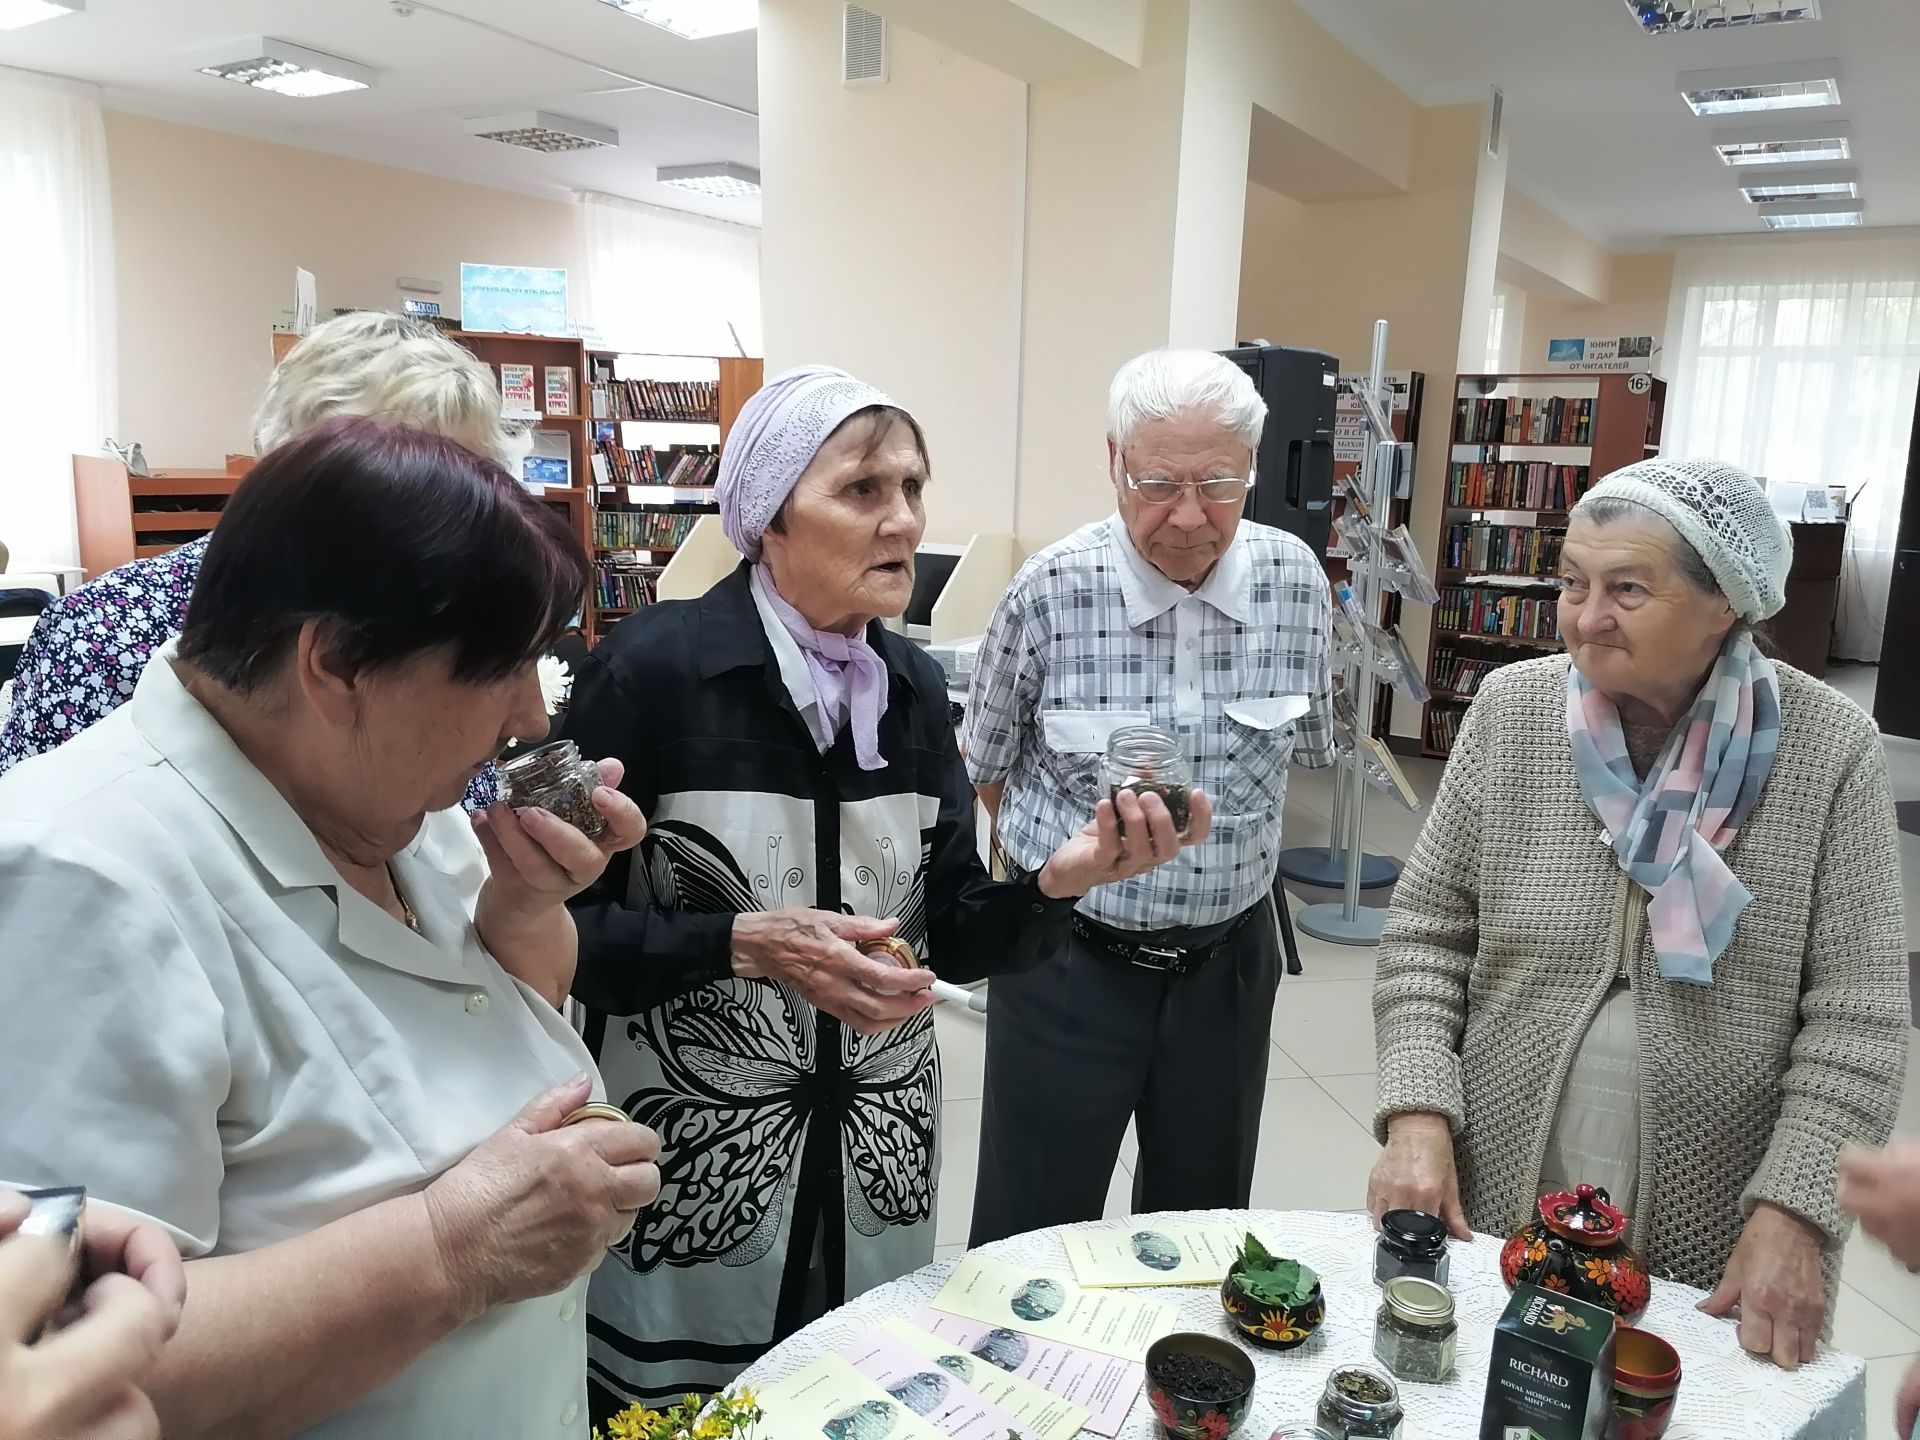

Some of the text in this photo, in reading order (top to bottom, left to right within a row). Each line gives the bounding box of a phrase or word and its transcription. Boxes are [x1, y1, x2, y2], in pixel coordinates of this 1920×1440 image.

[1582, 362, 1629, 370] ЧИТАТЕЛЕЙ
[1629, 378, 1651, 390] 16+
[505, 392, 531, 400] КУРИТЬ
[1524, 1296, 1547, 1326] RICHARD
[1509, 1357, 1569, 1388] RICHARD
[1501, 1379, 1571, 1410] ROYAL MOROCCAN
[1524, 1395, 1545, 1408] MINT
